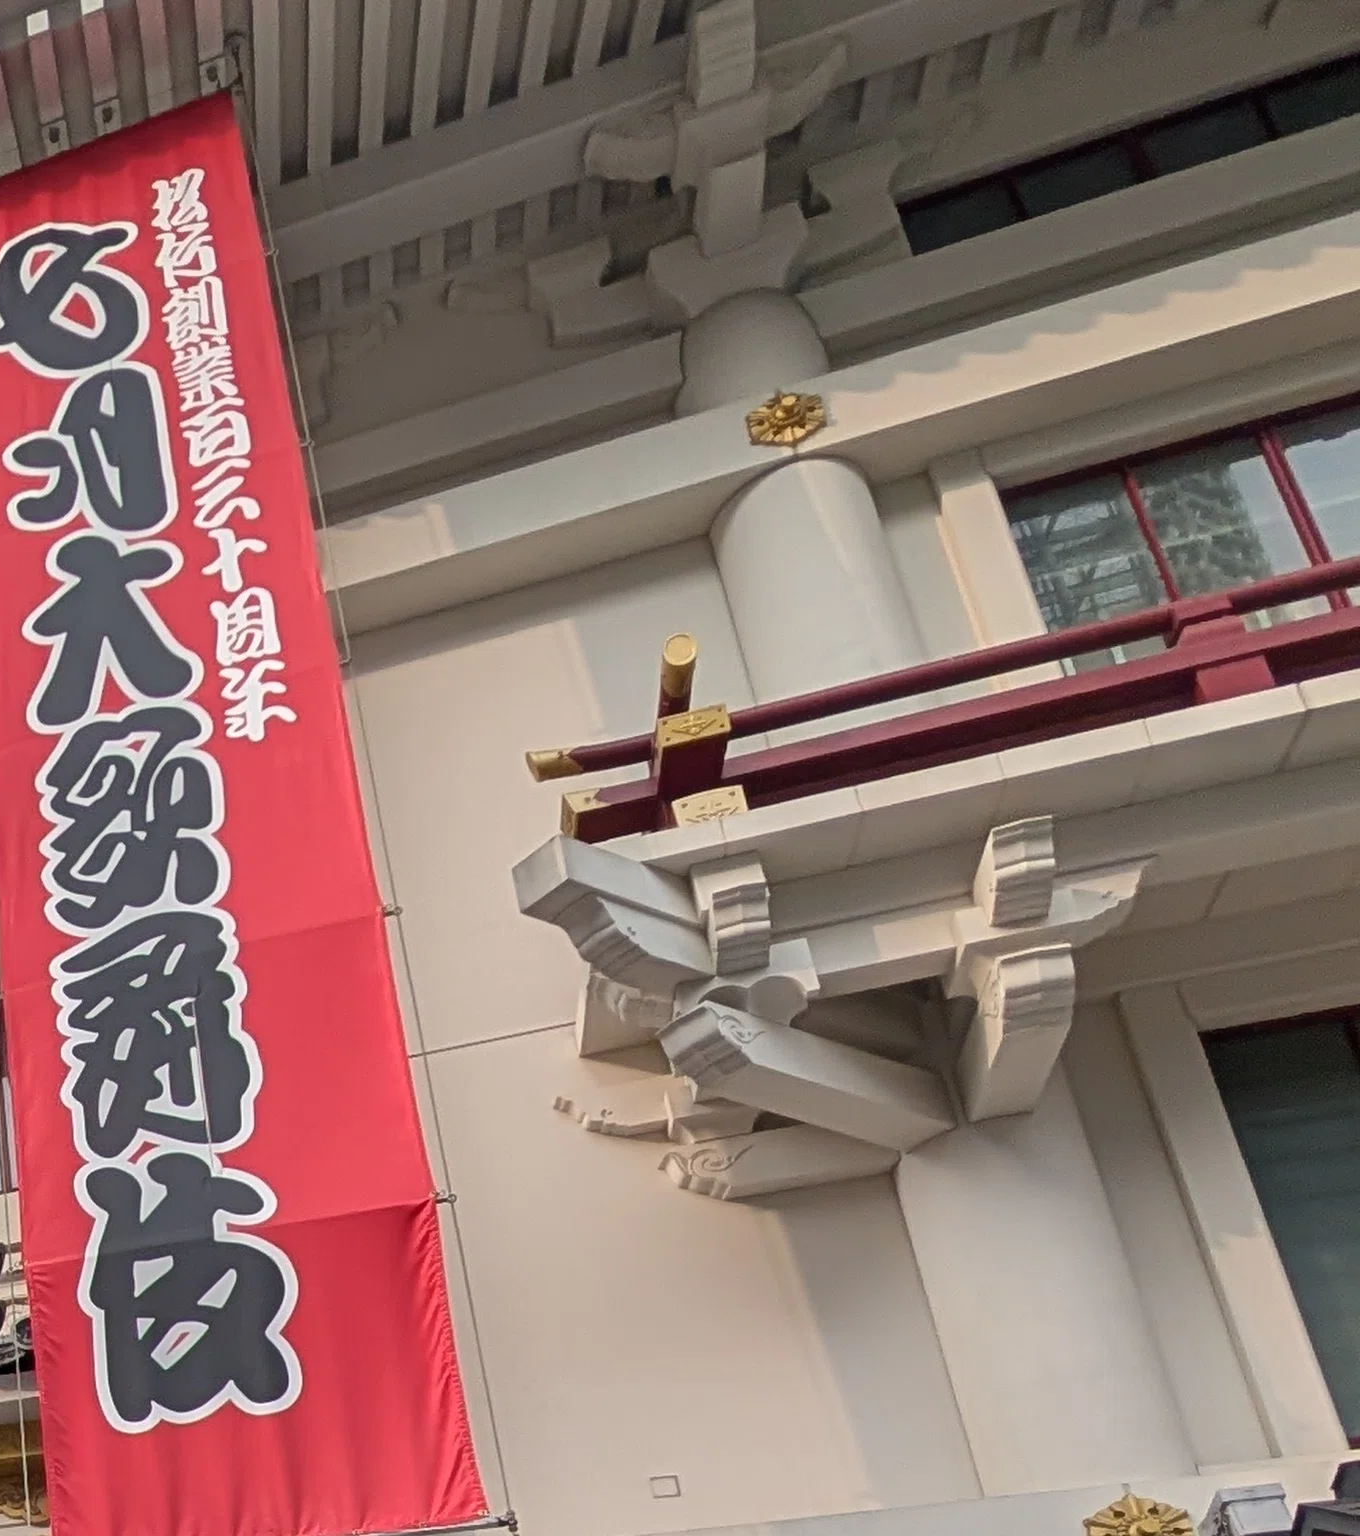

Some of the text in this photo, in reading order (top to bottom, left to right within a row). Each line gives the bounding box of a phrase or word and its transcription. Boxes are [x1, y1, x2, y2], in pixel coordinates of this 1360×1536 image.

[151, 167, 297, 741] 松竹創業百三十周年
